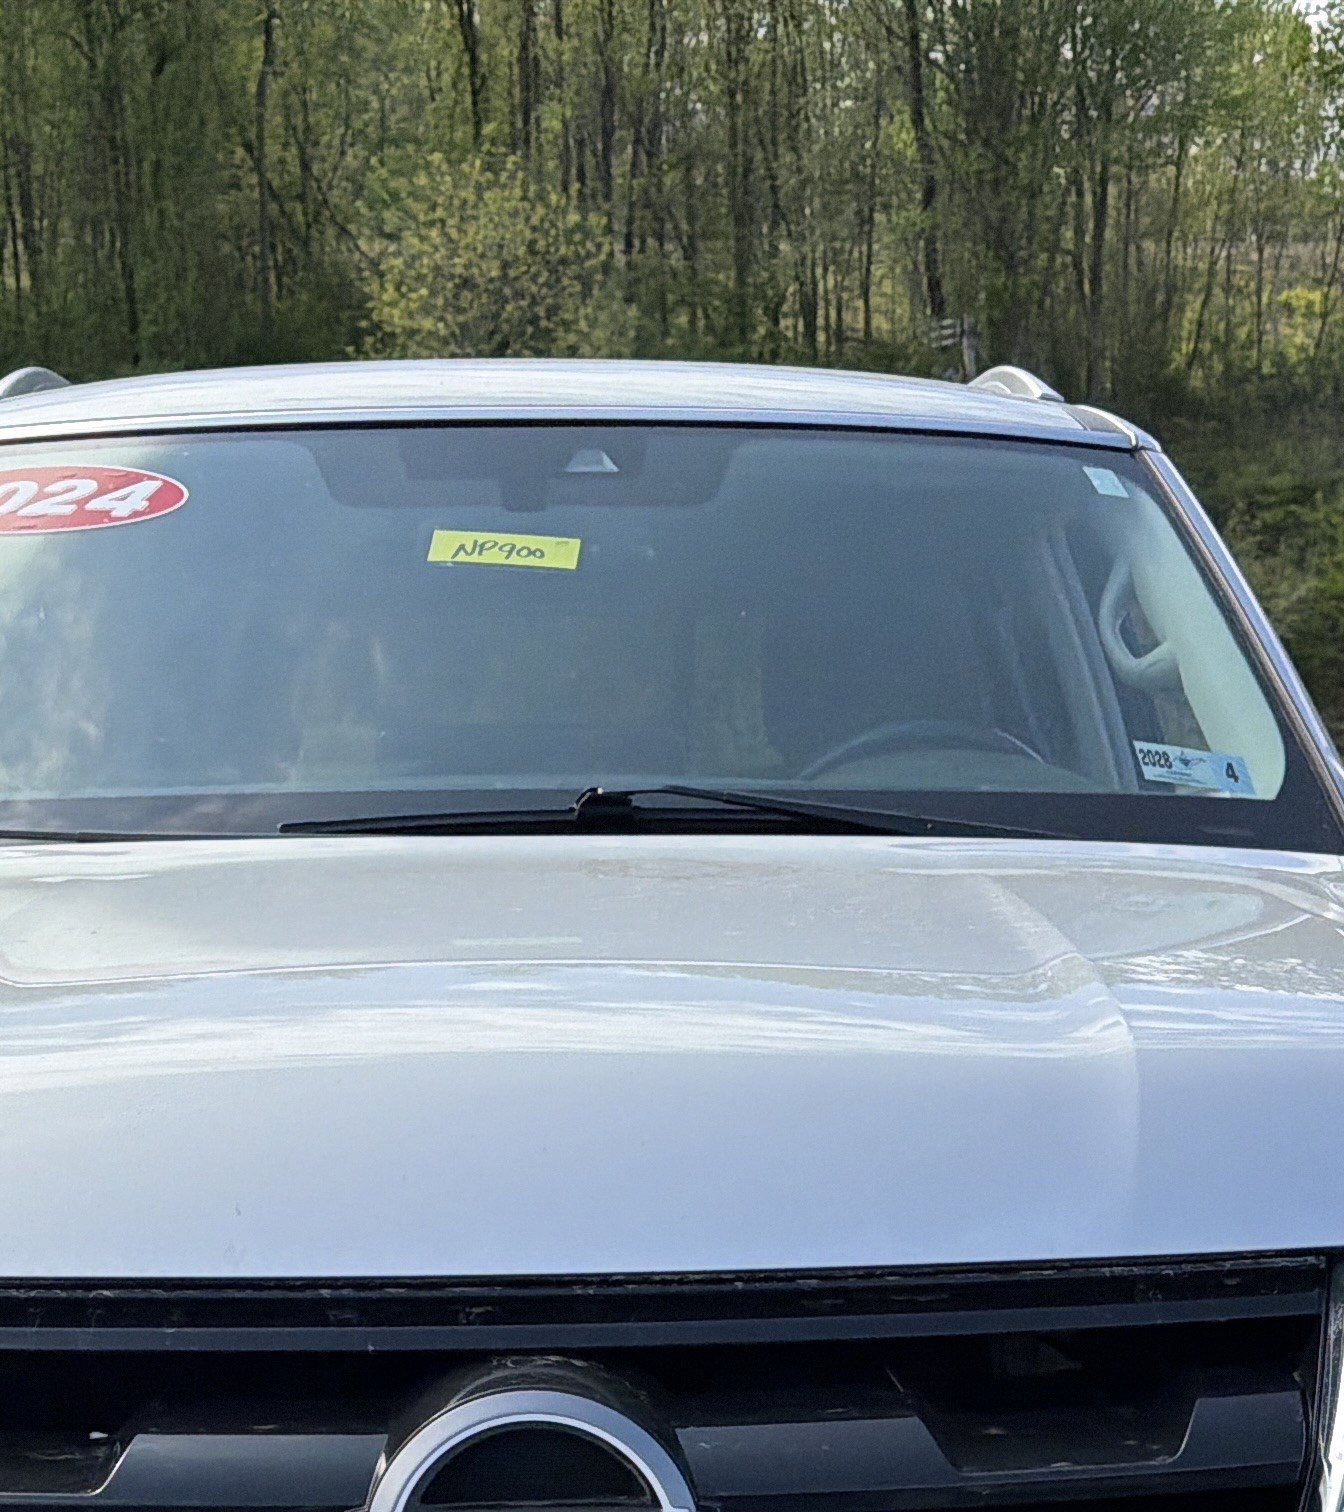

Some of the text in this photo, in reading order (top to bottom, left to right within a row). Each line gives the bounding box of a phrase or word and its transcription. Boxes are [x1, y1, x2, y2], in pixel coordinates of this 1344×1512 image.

[451, 539, 545, 560] NP900
[1138, 749, 1173, 769] 2028
[1225, 762, 1240, 783] 4
